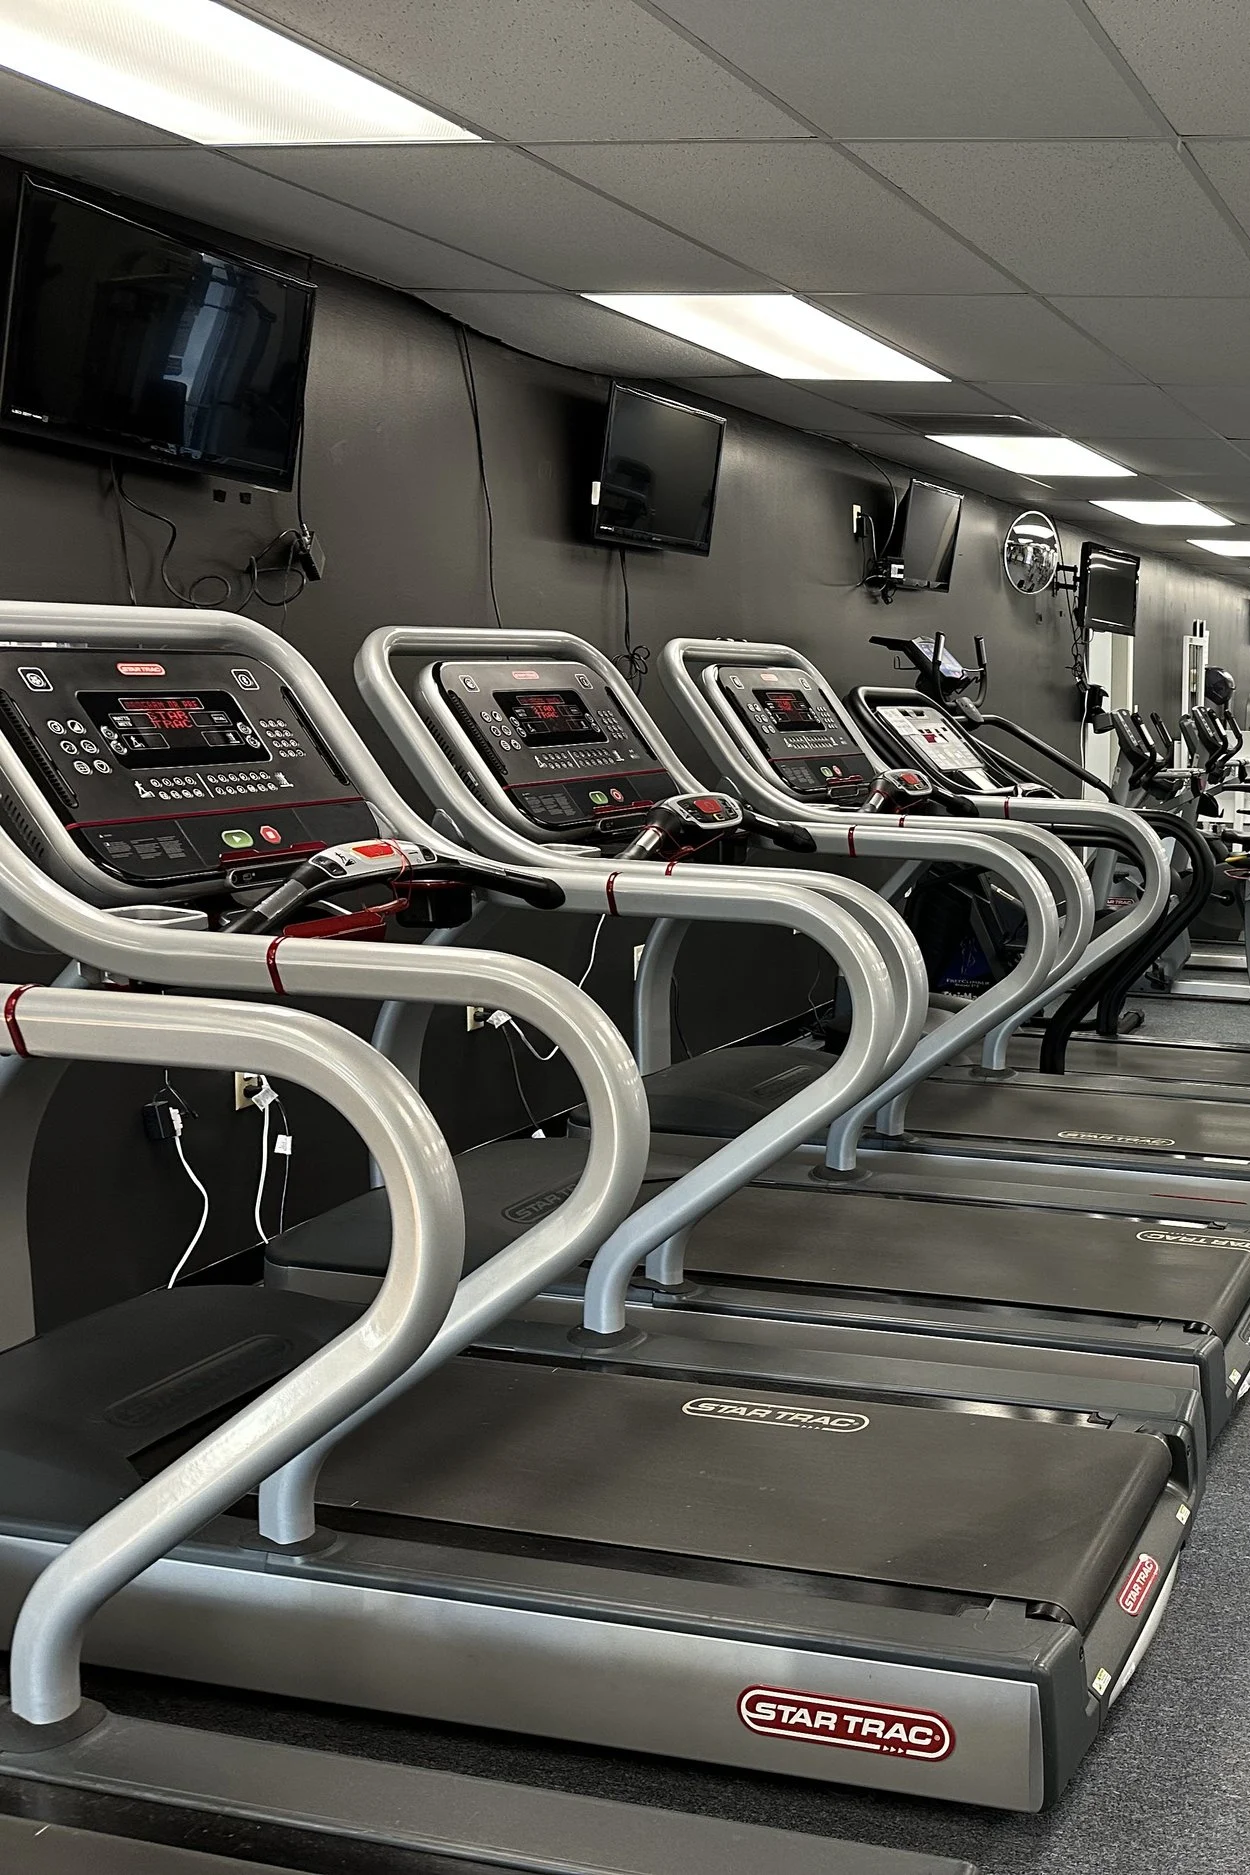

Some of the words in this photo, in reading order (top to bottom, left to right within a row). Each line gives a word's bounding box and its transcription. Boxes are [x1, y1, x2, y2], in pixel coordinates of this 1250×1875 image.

[147, 711, 189, 720] STAR
[152, 719, 193, 729] TRAC
[515, 1193, 561, 1220] STAR
[1146, 1233, 1208, 1244] TRAC
[697, 1403, 773, 1418] STAR
[775, 1411, 856, 1427] TRAC
[1124, 1583, 1142, 1609] STAR
[1136, 1560, 1154, 1586] TRAC
[751, 1702, 838, 1731] STAR
[843, 1714, 934, 1746] TRAC
